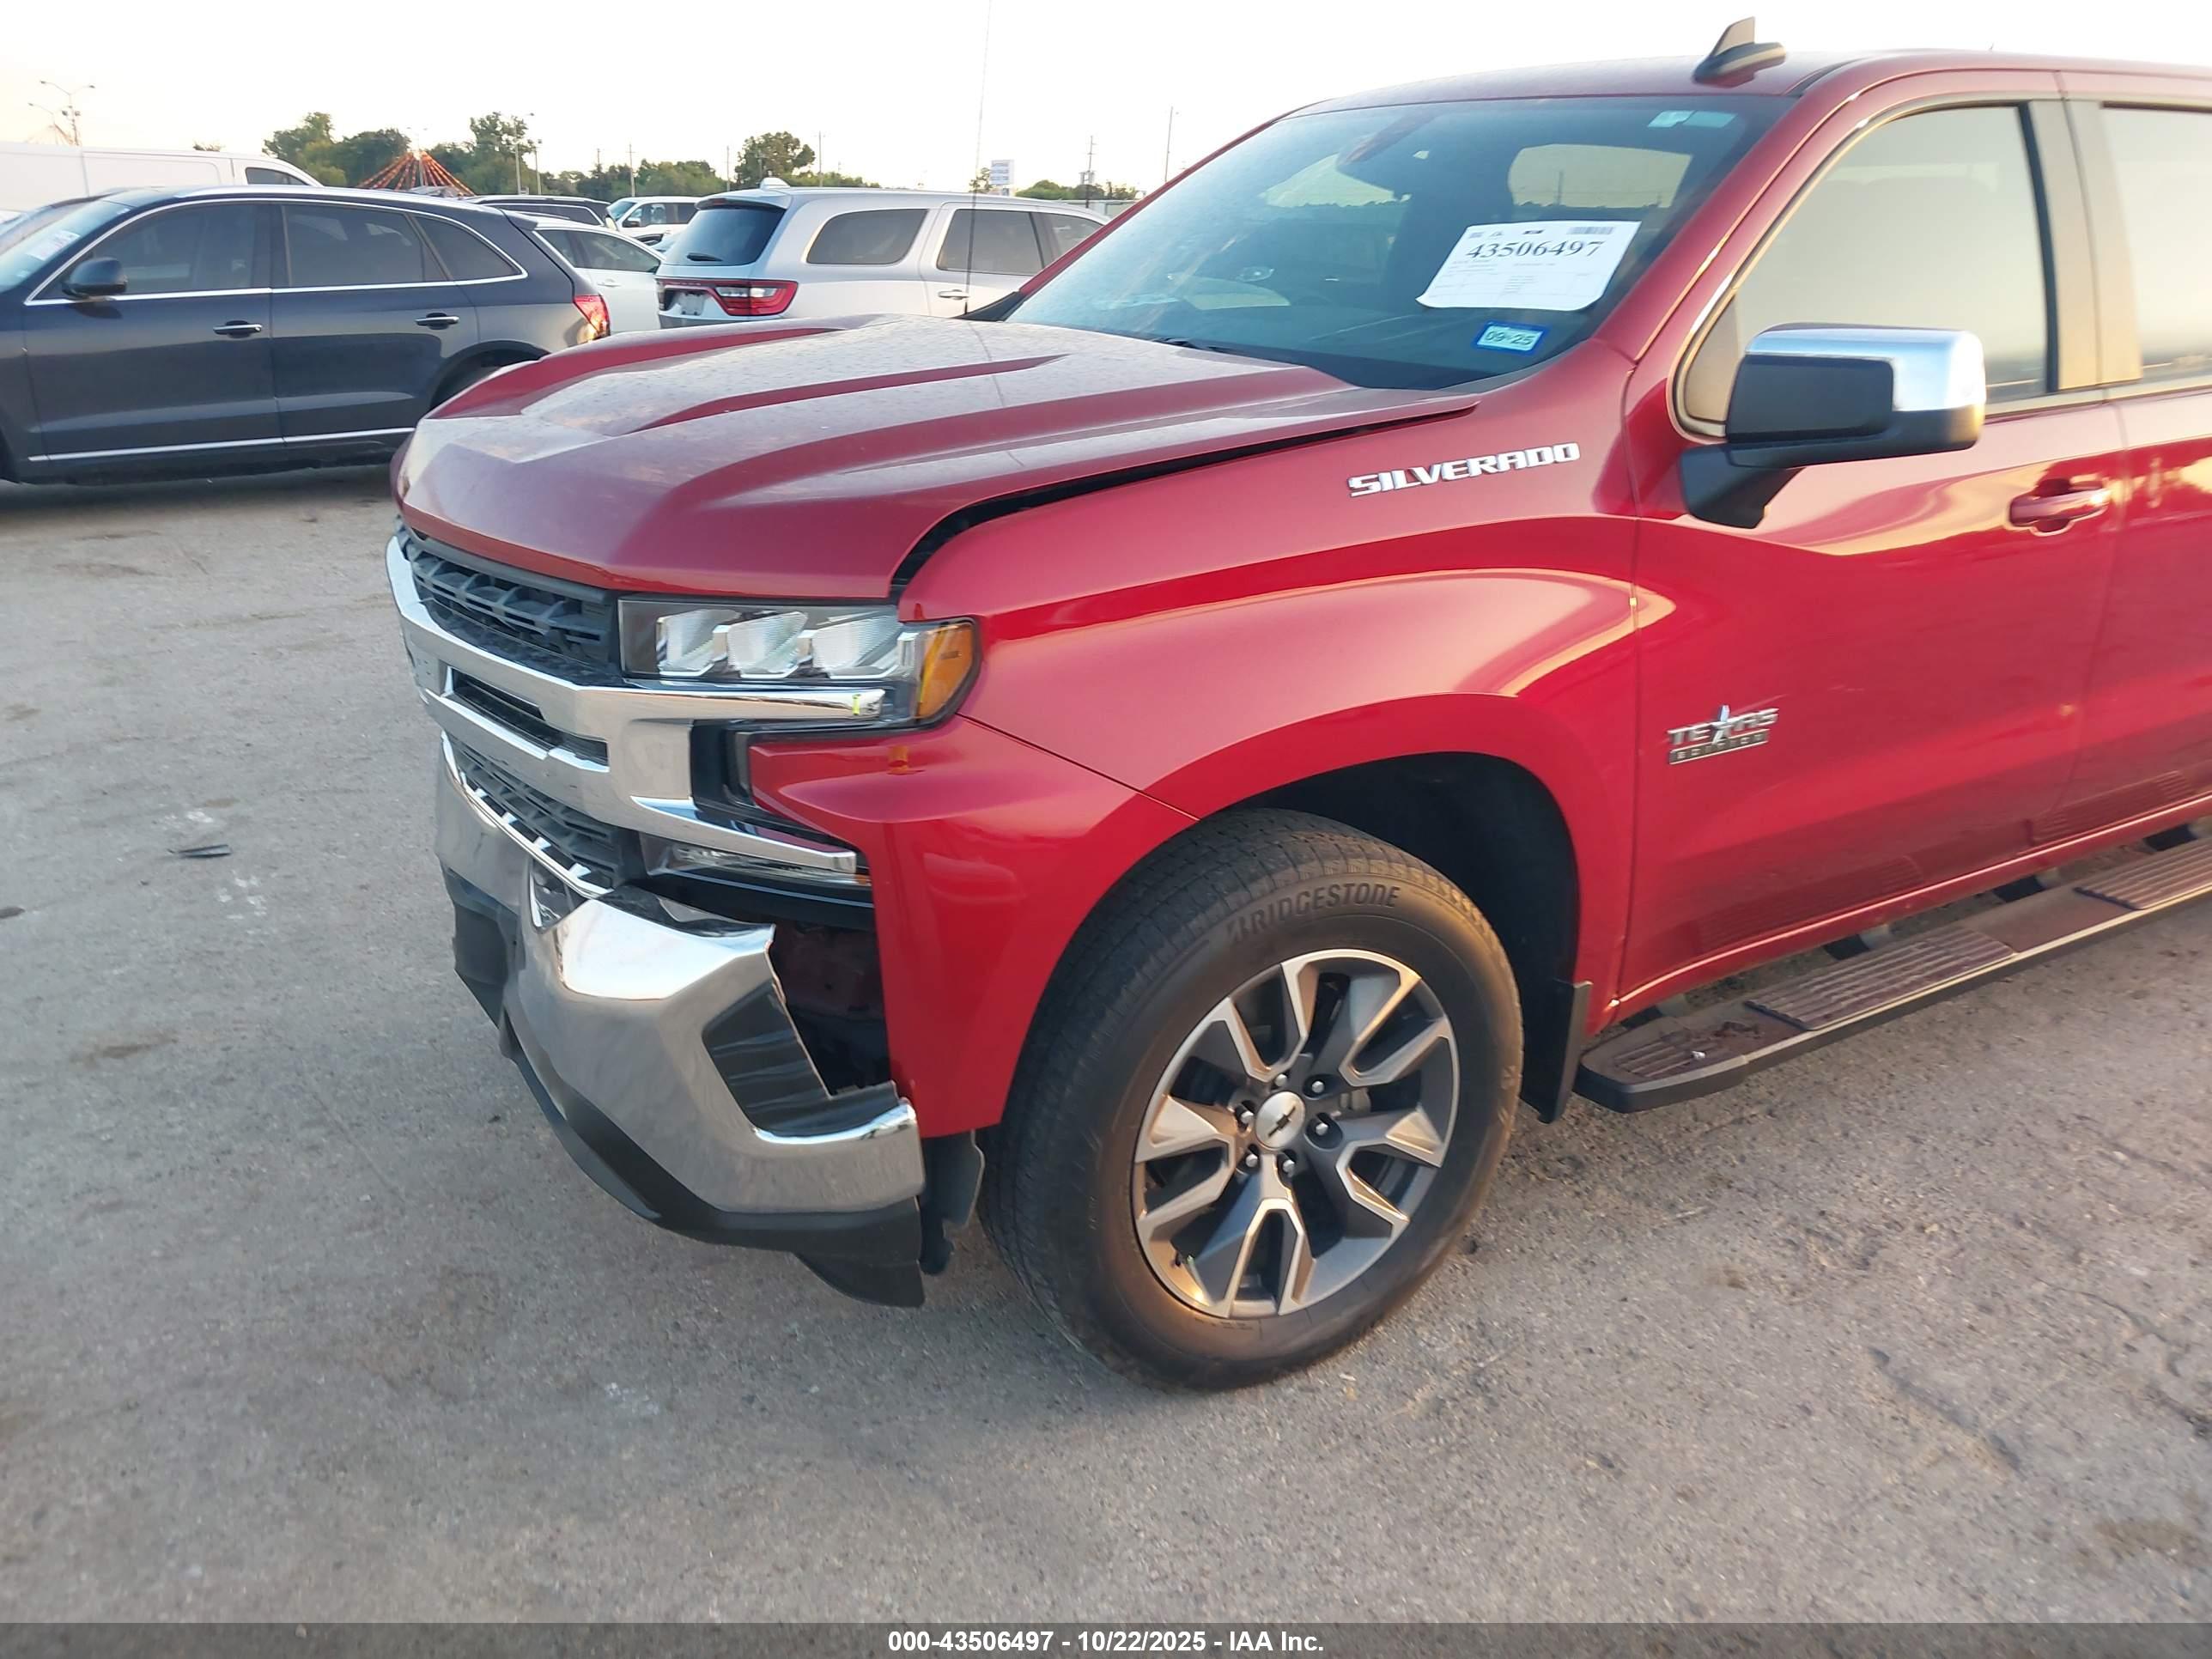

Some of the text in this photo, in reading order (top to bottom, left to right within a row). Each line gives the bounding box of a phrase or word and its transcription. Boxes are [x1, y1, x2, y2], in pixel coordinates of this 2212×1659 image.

[1465, 240, 1606, 258] 43506497
[1346, 441, 1581, 497] SILVERADO
[1667, 704, 1779, 745] TEXAS
[1225, 882, 1401, 944] BRIDGESTONE
